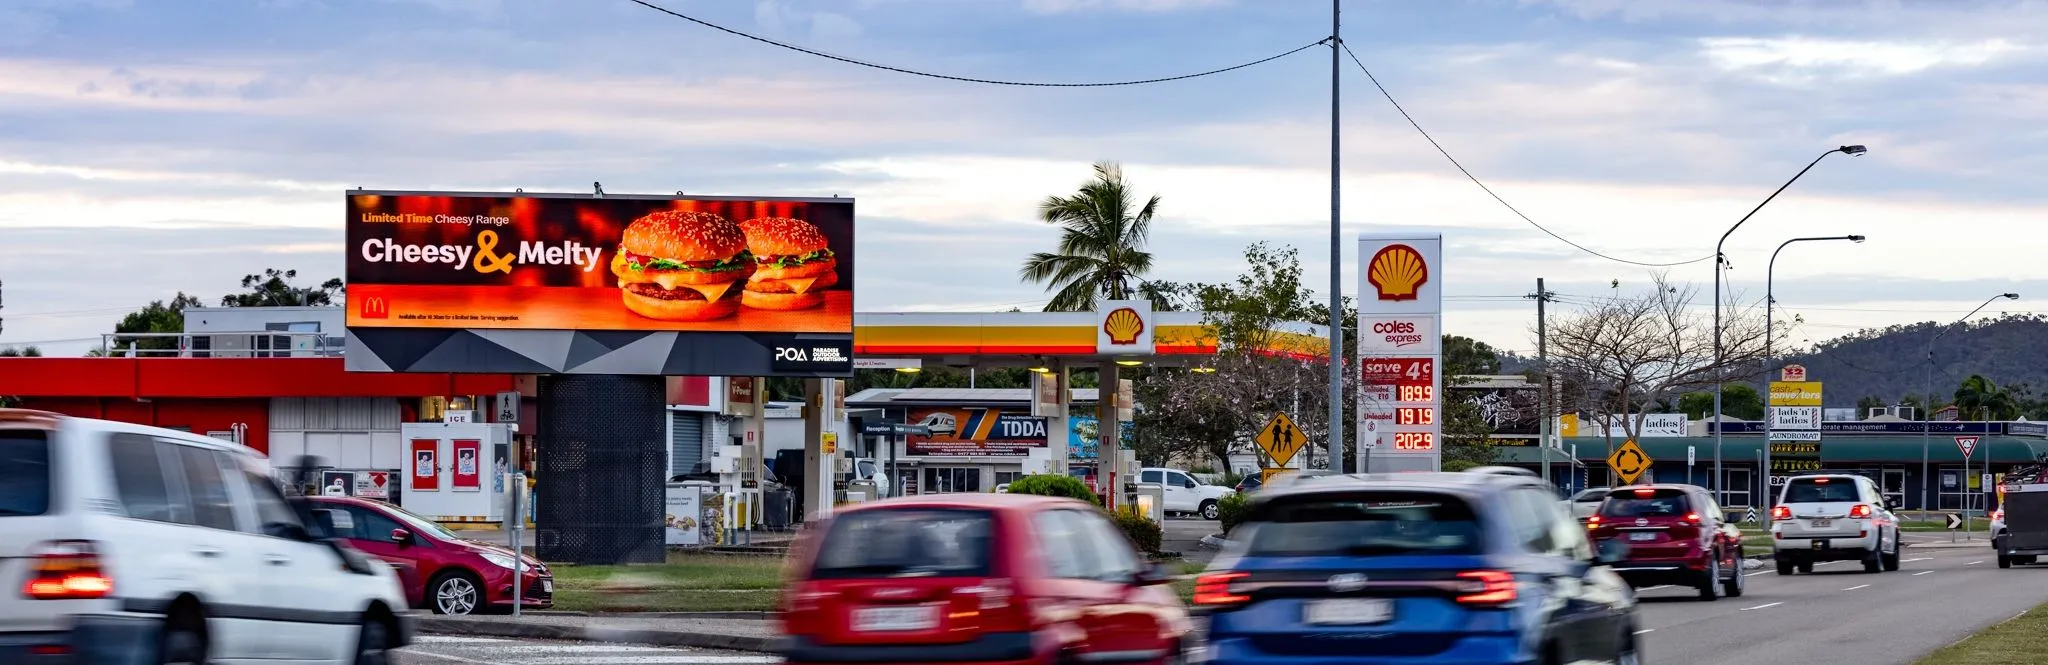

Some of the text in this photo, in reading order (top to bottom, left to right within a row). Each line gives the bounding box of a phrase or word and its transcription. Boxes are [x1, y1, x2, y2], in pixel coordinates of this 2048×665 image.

[361, 212, 509, 226] Limited Time Cheesy Range
[361, 229, 603, 275] Cheesy & Melty
[1373, 320, 1415, 334] coles
[1385, 334, 1423, 345] express
[775, 346, 808, 361] POA
[1365, 363, 1402, 373] save
[1399, 385, 1433, 402] 189.9
[1770, 385, 1790, 393] cash
[1363, 408, 1433, 425] Unleaded 191.9
[1778, 408, 1799, 416] lads
[1645, 418, 1678, 428] ladies
[1779, 416, 1809, 425] ladies
[1842, 423, 1887, 432] management
[1001, 420, 1046, 437] TDDA
[1395, 433, 1433, 450] 202.9
